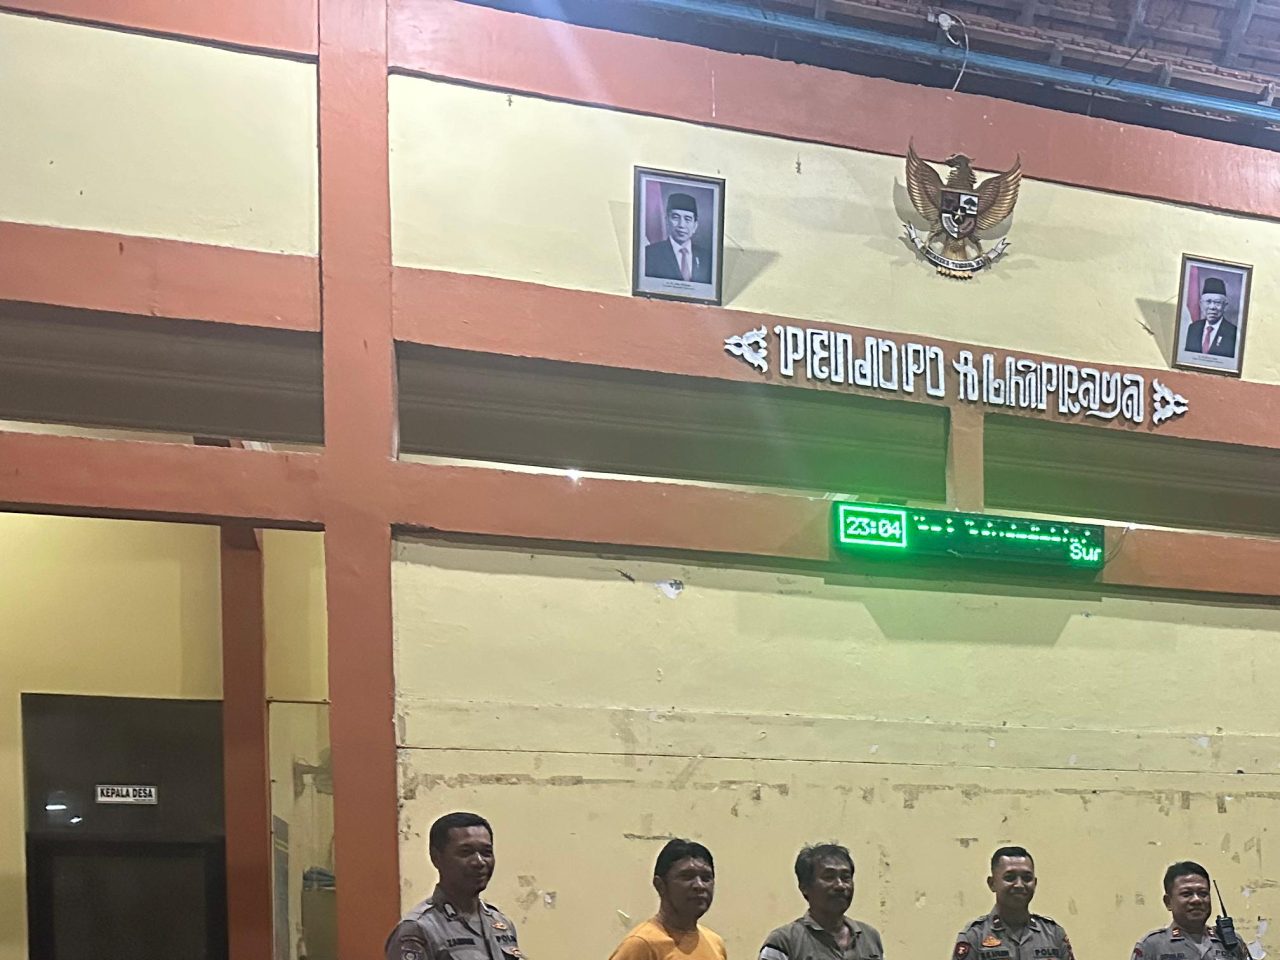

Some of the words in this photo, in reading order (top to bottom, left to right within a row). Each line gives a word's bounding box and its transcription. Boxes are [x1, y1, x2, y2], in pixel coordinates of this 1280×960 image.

[846, 517, 901, 539] 23:04
[100, 787, 130, 798] KEPALA
[132, 788, 153, 798] DESA
